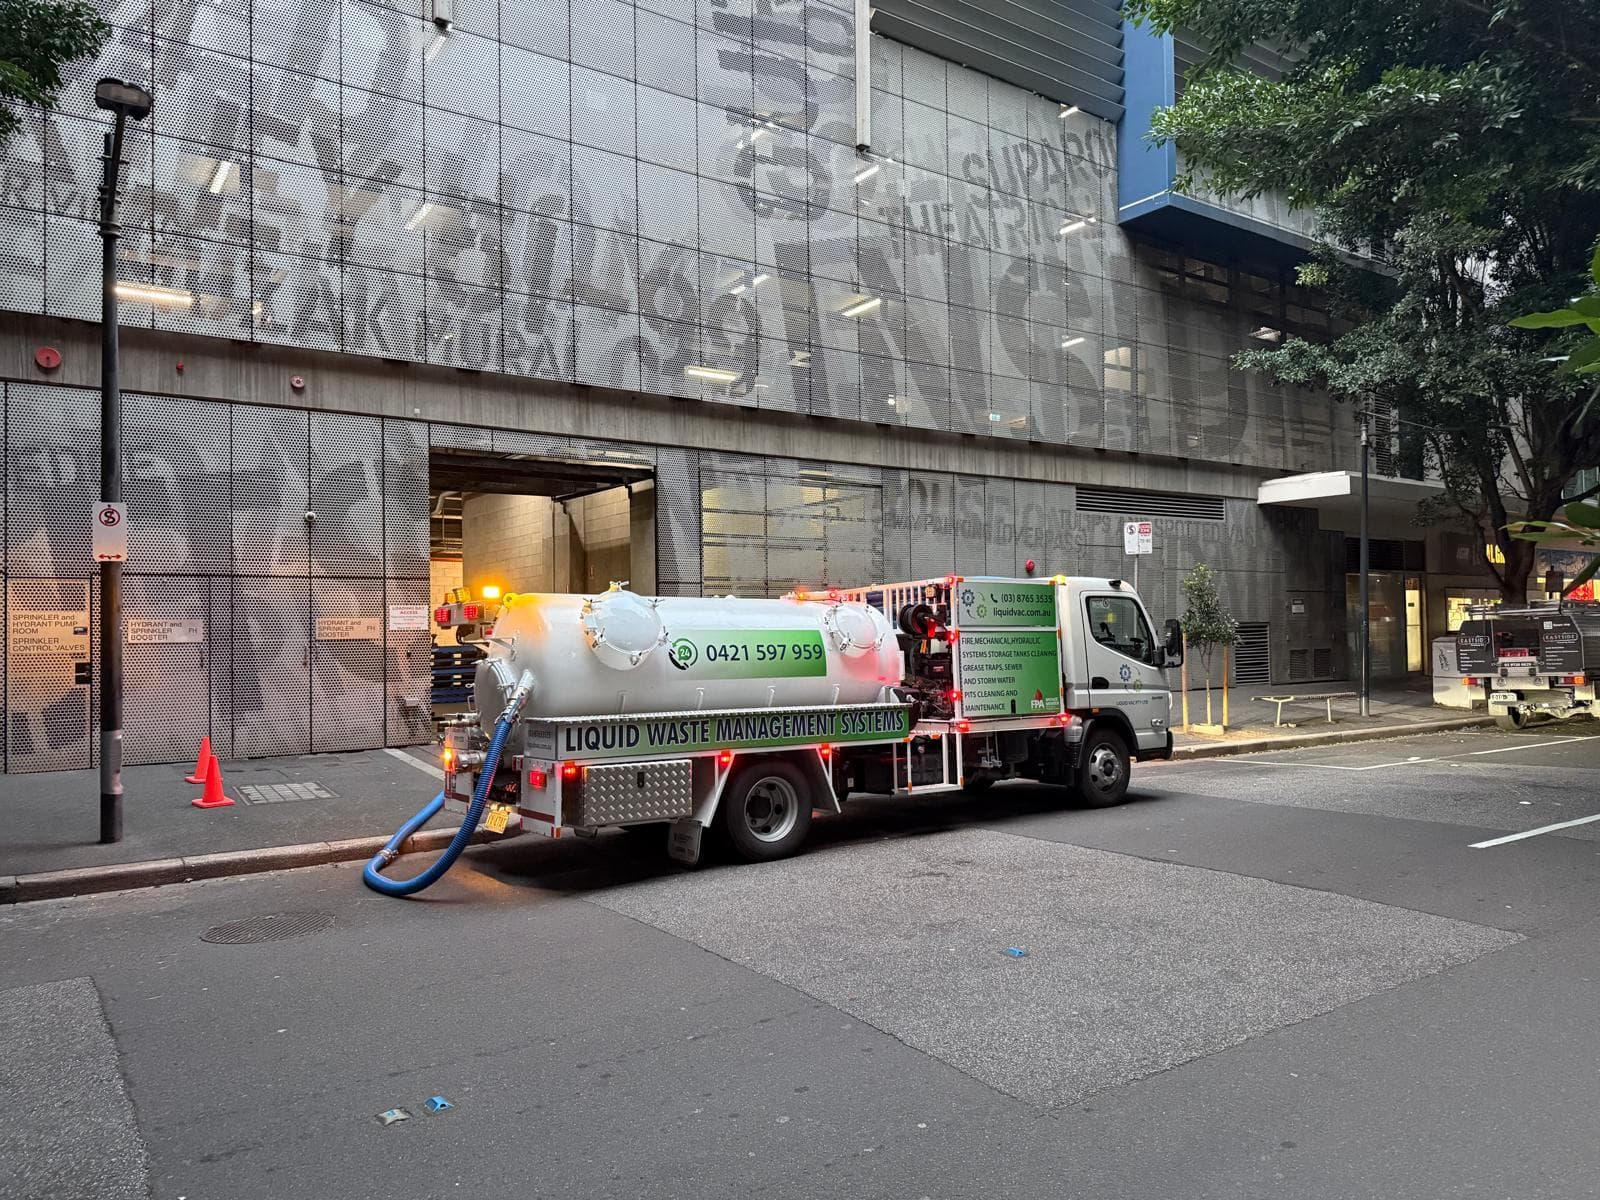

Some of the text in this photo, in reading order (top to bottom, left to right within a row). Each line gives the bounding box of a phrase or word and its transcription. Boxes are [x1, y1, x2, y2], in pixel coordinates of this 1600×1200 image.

[1001, 593, 1053, 604] (03) 8765 3535
[993, 607, 1051, 618] liquidvac.com.au
[679, 647, 690, 657] 24
[706, 644, 823, 661] 0421 597 959
[988, 650, 1013, 658] STORAGE
[977, 690, 1005, 698] CLEANING
[1005, 689, 1018, 697] AND
[965, 703, 1006, 711] MAINTENANCE
[1031, 700, 1045, 709] FPA
[565, 710, 904, 752] LIQUID WASTE MANAGEMENT SYSTEMS
